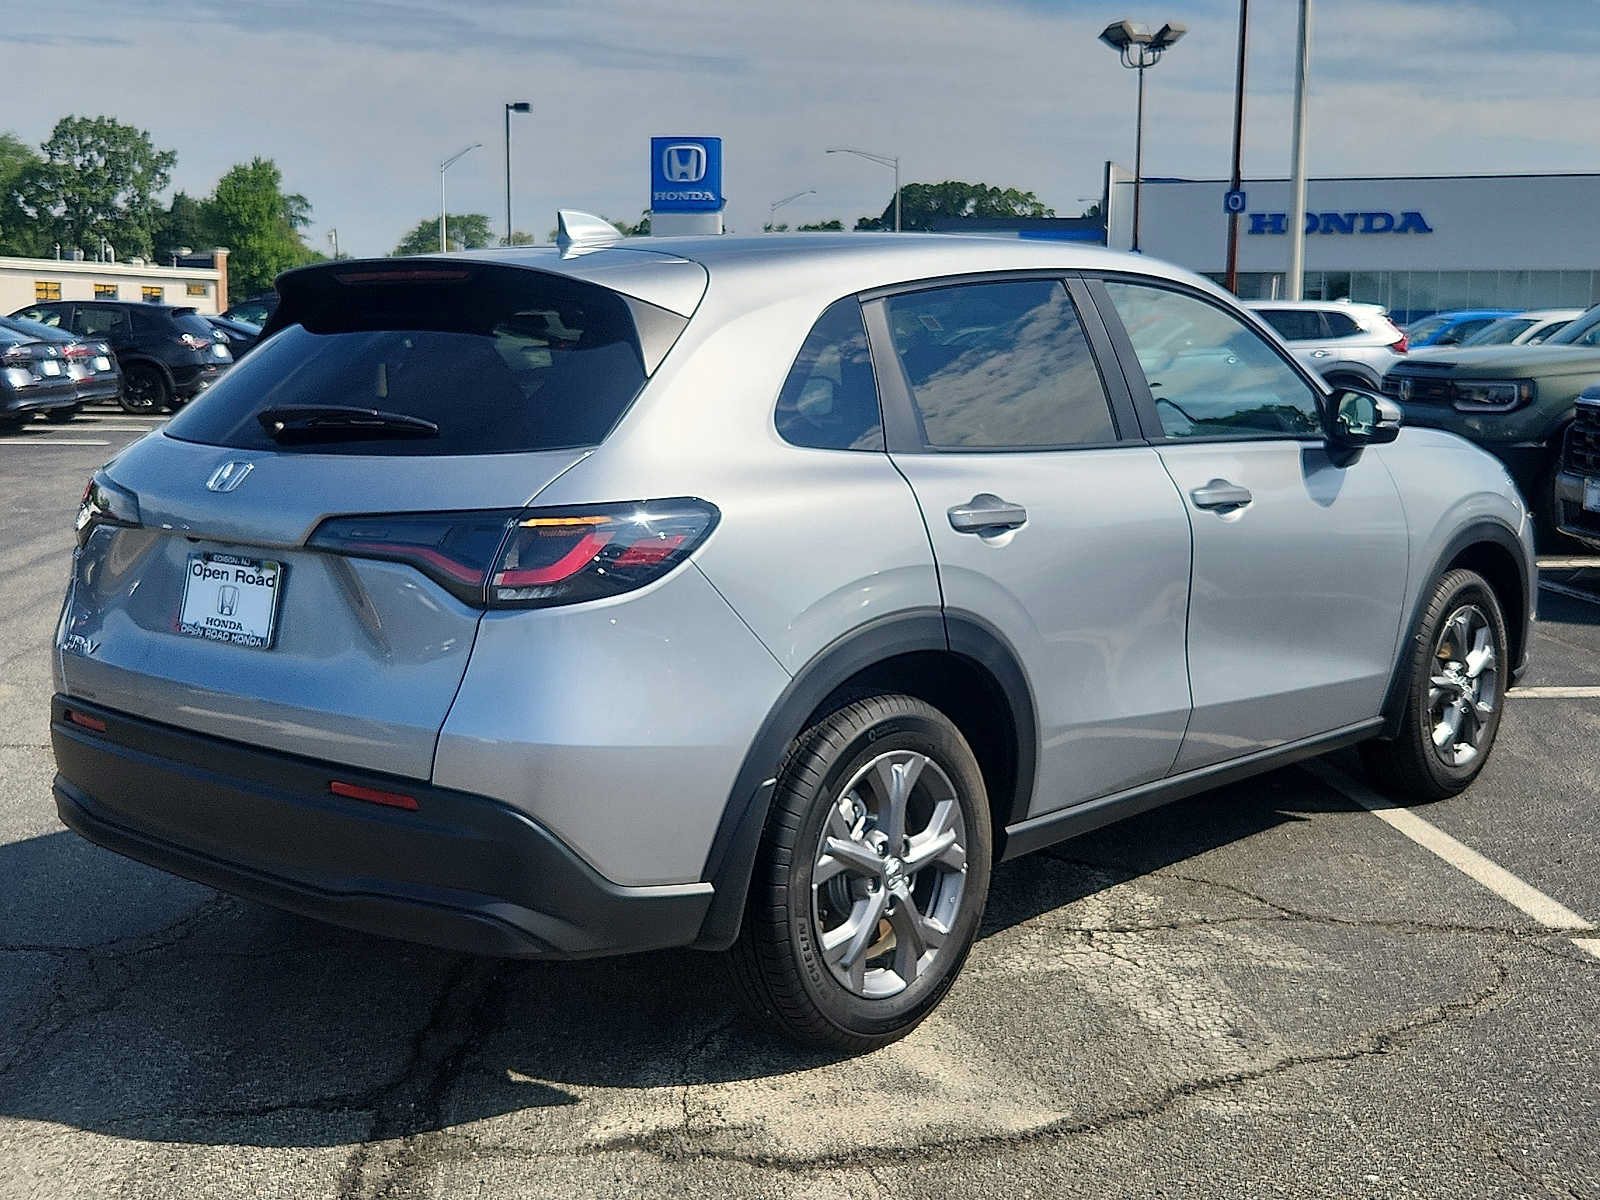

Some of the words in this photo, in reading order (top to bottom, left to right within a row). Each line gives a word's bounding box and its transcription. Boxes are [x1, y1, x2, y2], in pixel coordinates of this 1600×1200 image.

[654, 191, 716, 201] HONDA
[192, 563, 230, 582] Open
[235, 569, 276, 588] Road
[205, 616, 243, 631] HONDA
[180, 624, 204, 637] OPEN
[204, 627, 230, 641] ROAD
[231, 633, 263, 649] HONDA
